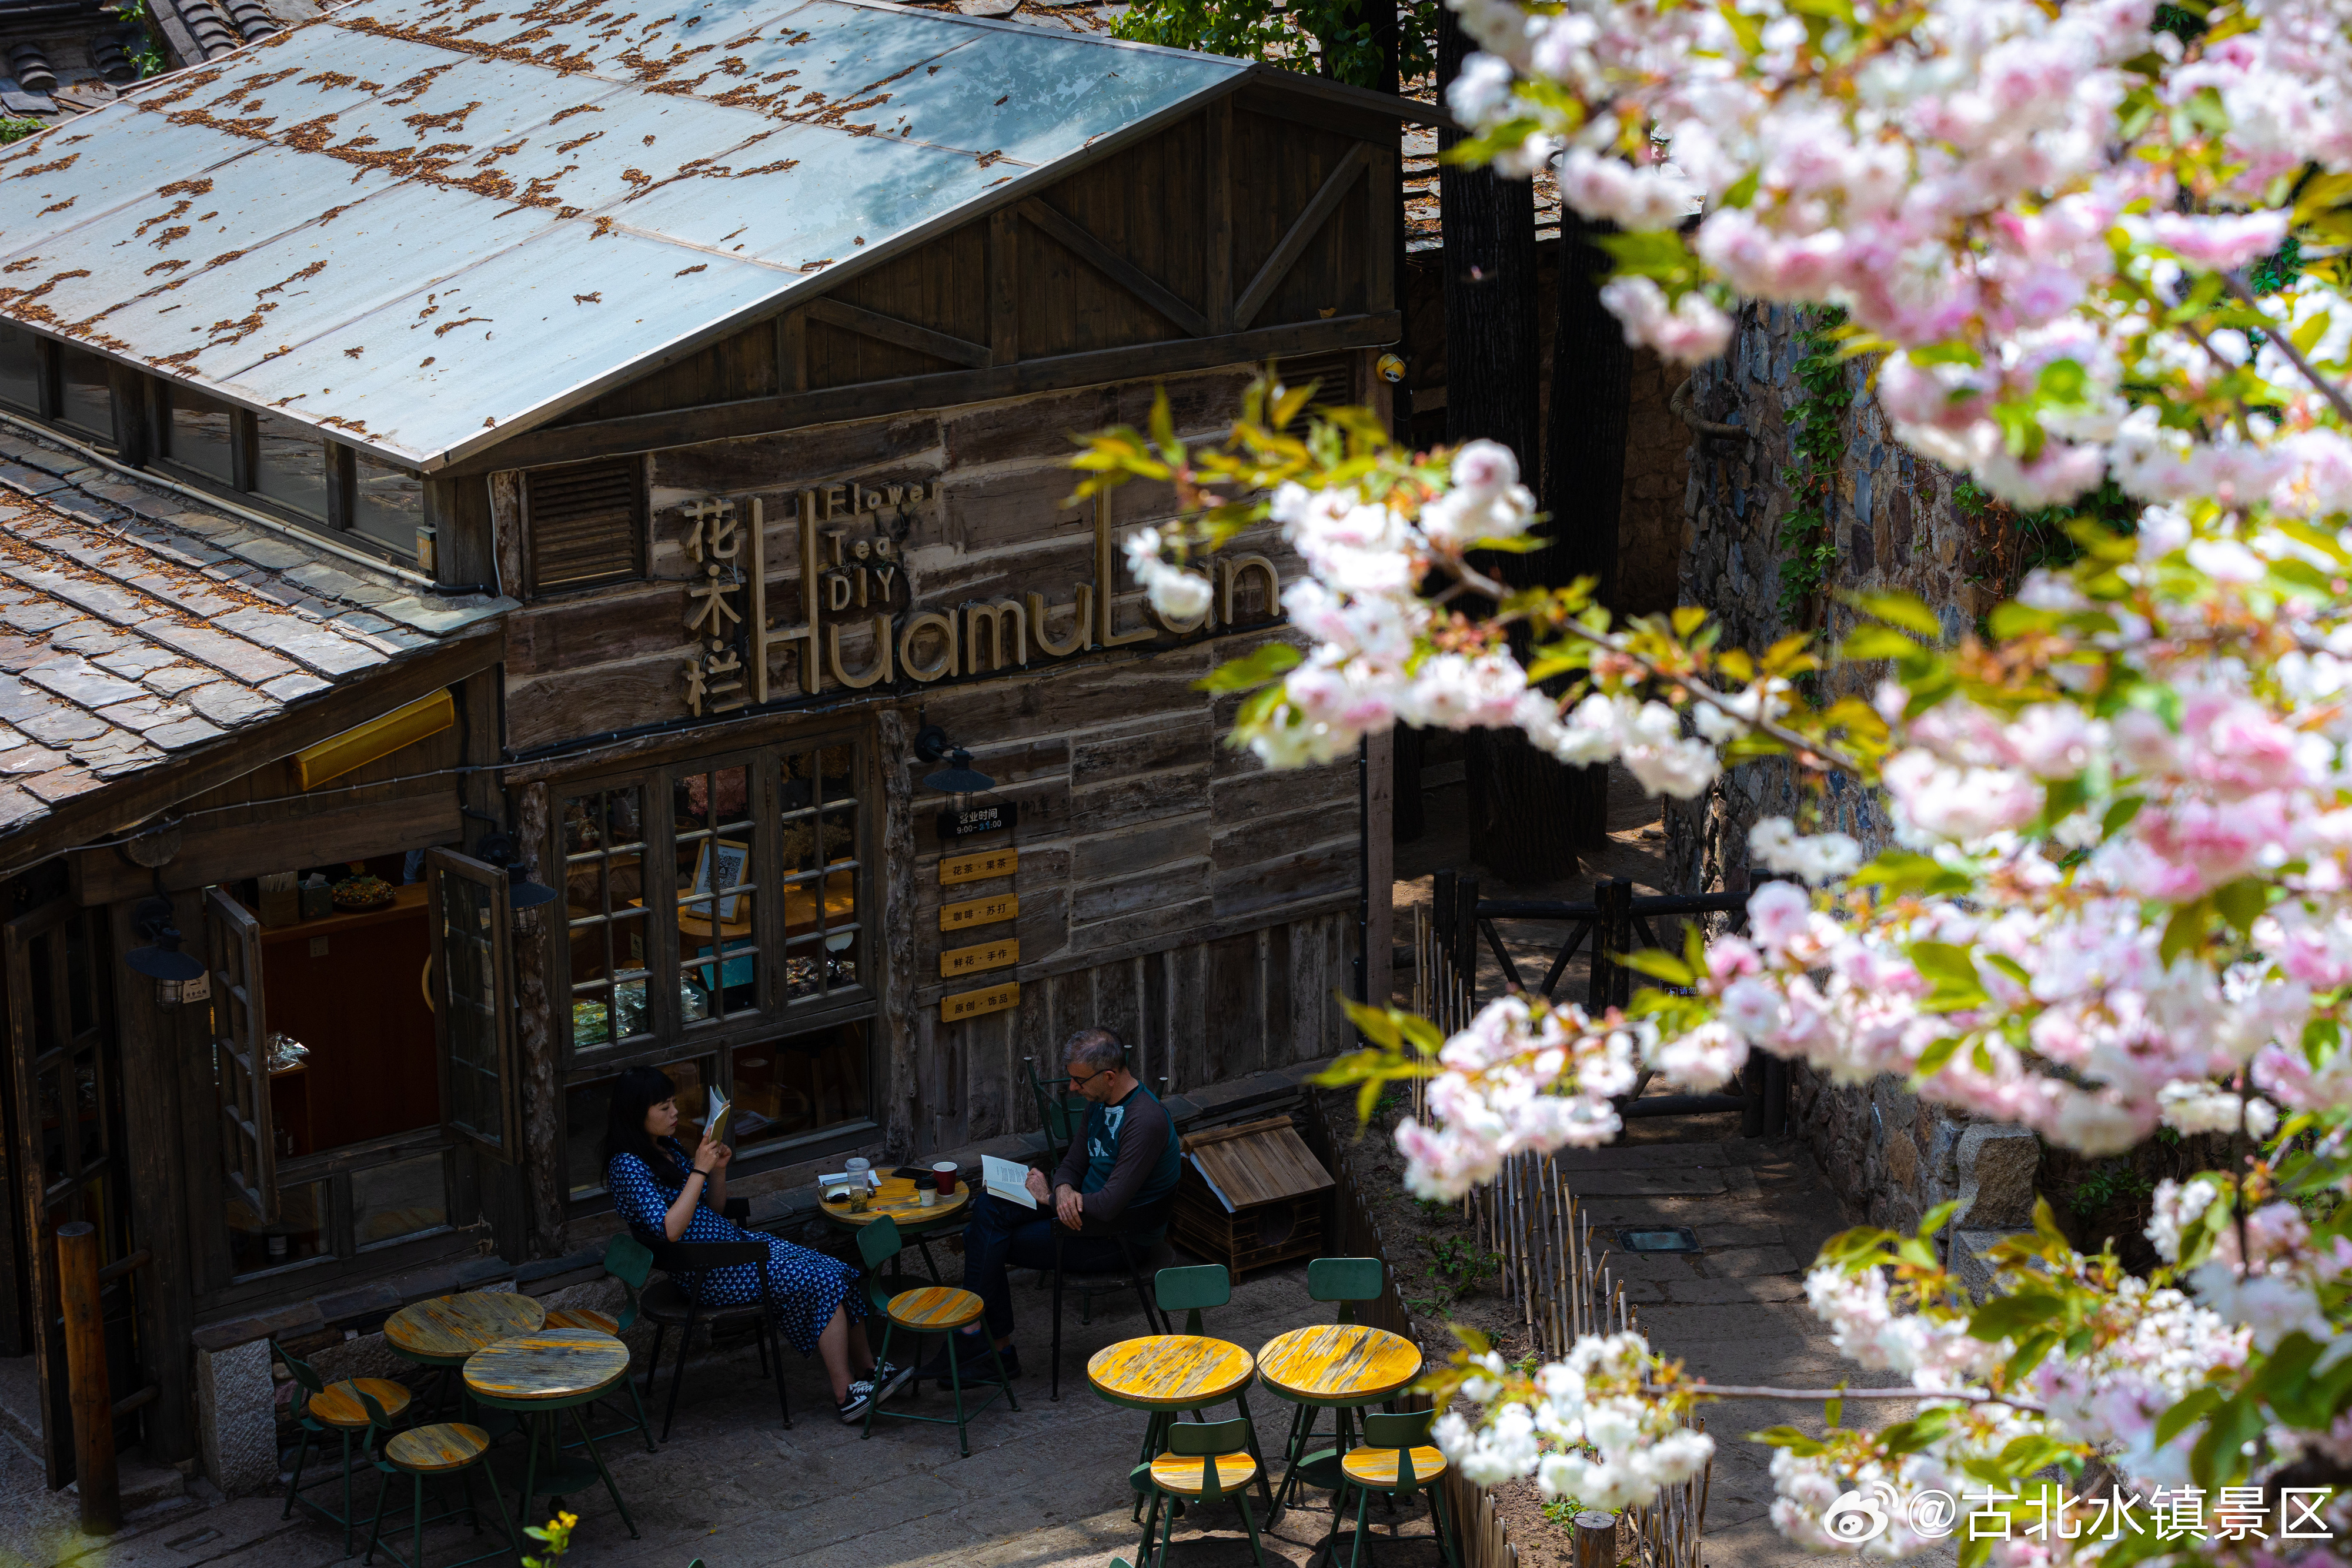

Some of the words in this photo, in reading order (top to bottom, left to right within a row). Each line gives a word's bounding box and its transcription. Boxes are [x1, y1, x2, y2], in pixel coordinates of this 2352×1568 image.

[819, 478, 944, 521] Flower
[824, 530, 891, 566] Tea
[826, 566, 895, 611] DIY
[960, 808, 997, 824] 营业时间
